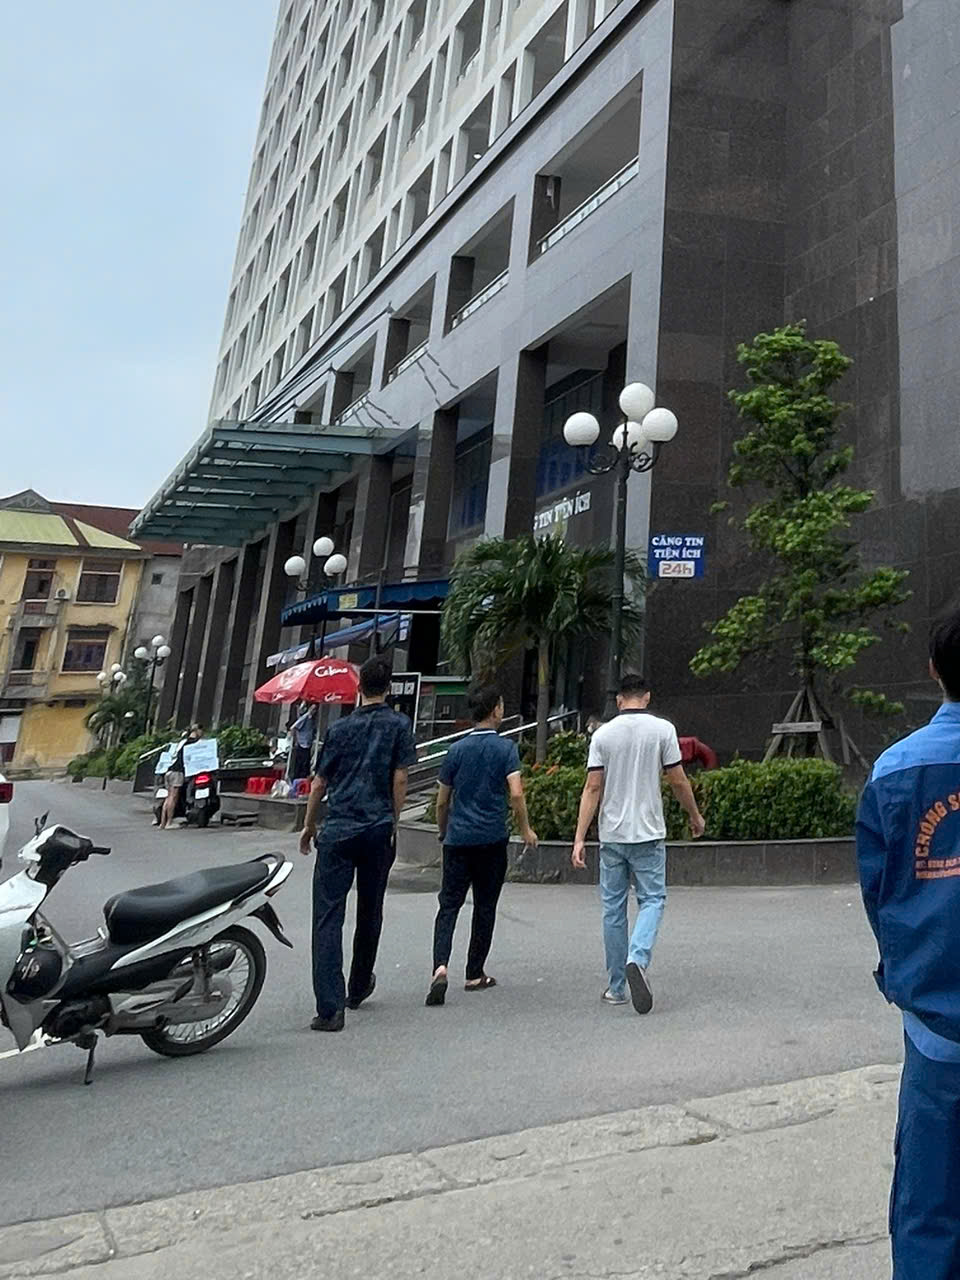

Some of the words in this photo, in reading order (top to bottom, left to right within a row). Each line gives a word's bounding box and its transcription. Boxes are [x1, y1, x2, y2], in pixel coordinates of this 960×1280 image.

[652, 534, 682, 546] CĂNG
[685, 537, 704, 546] TIN
[653, 547, 680, 560] TIỆN
[682, 546, 701, 558] ÍCH
[662, 563, 692, 575] 24h
